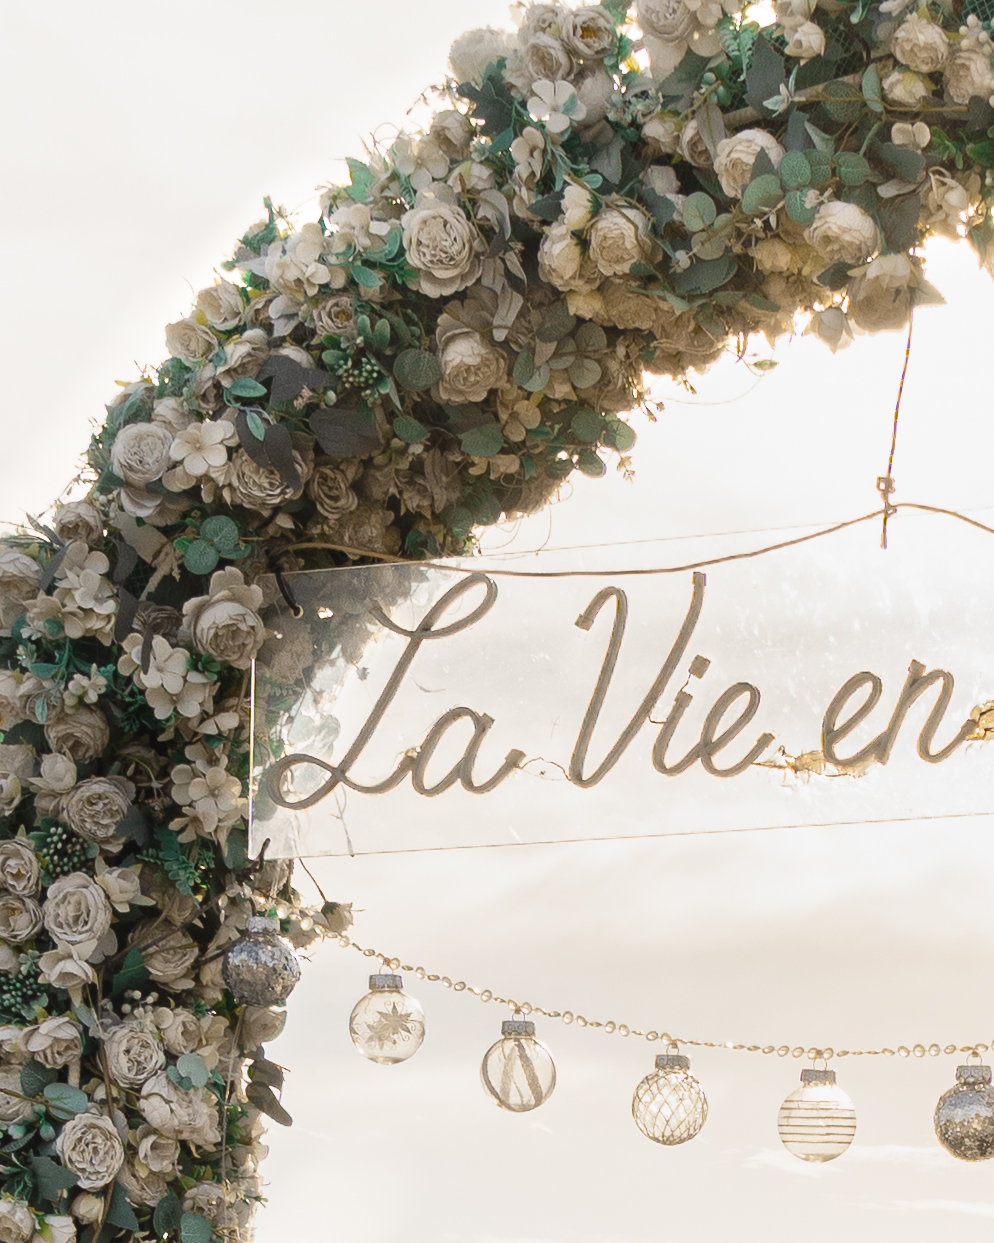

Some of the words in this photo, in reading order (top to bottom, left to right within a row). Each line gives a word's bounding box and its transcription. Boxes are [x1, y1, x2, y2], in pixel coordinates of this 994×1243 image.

[267, 572, 528, 810] La
[568, 571, 776, 788] Vie
[820, 659, 978, 767] en
